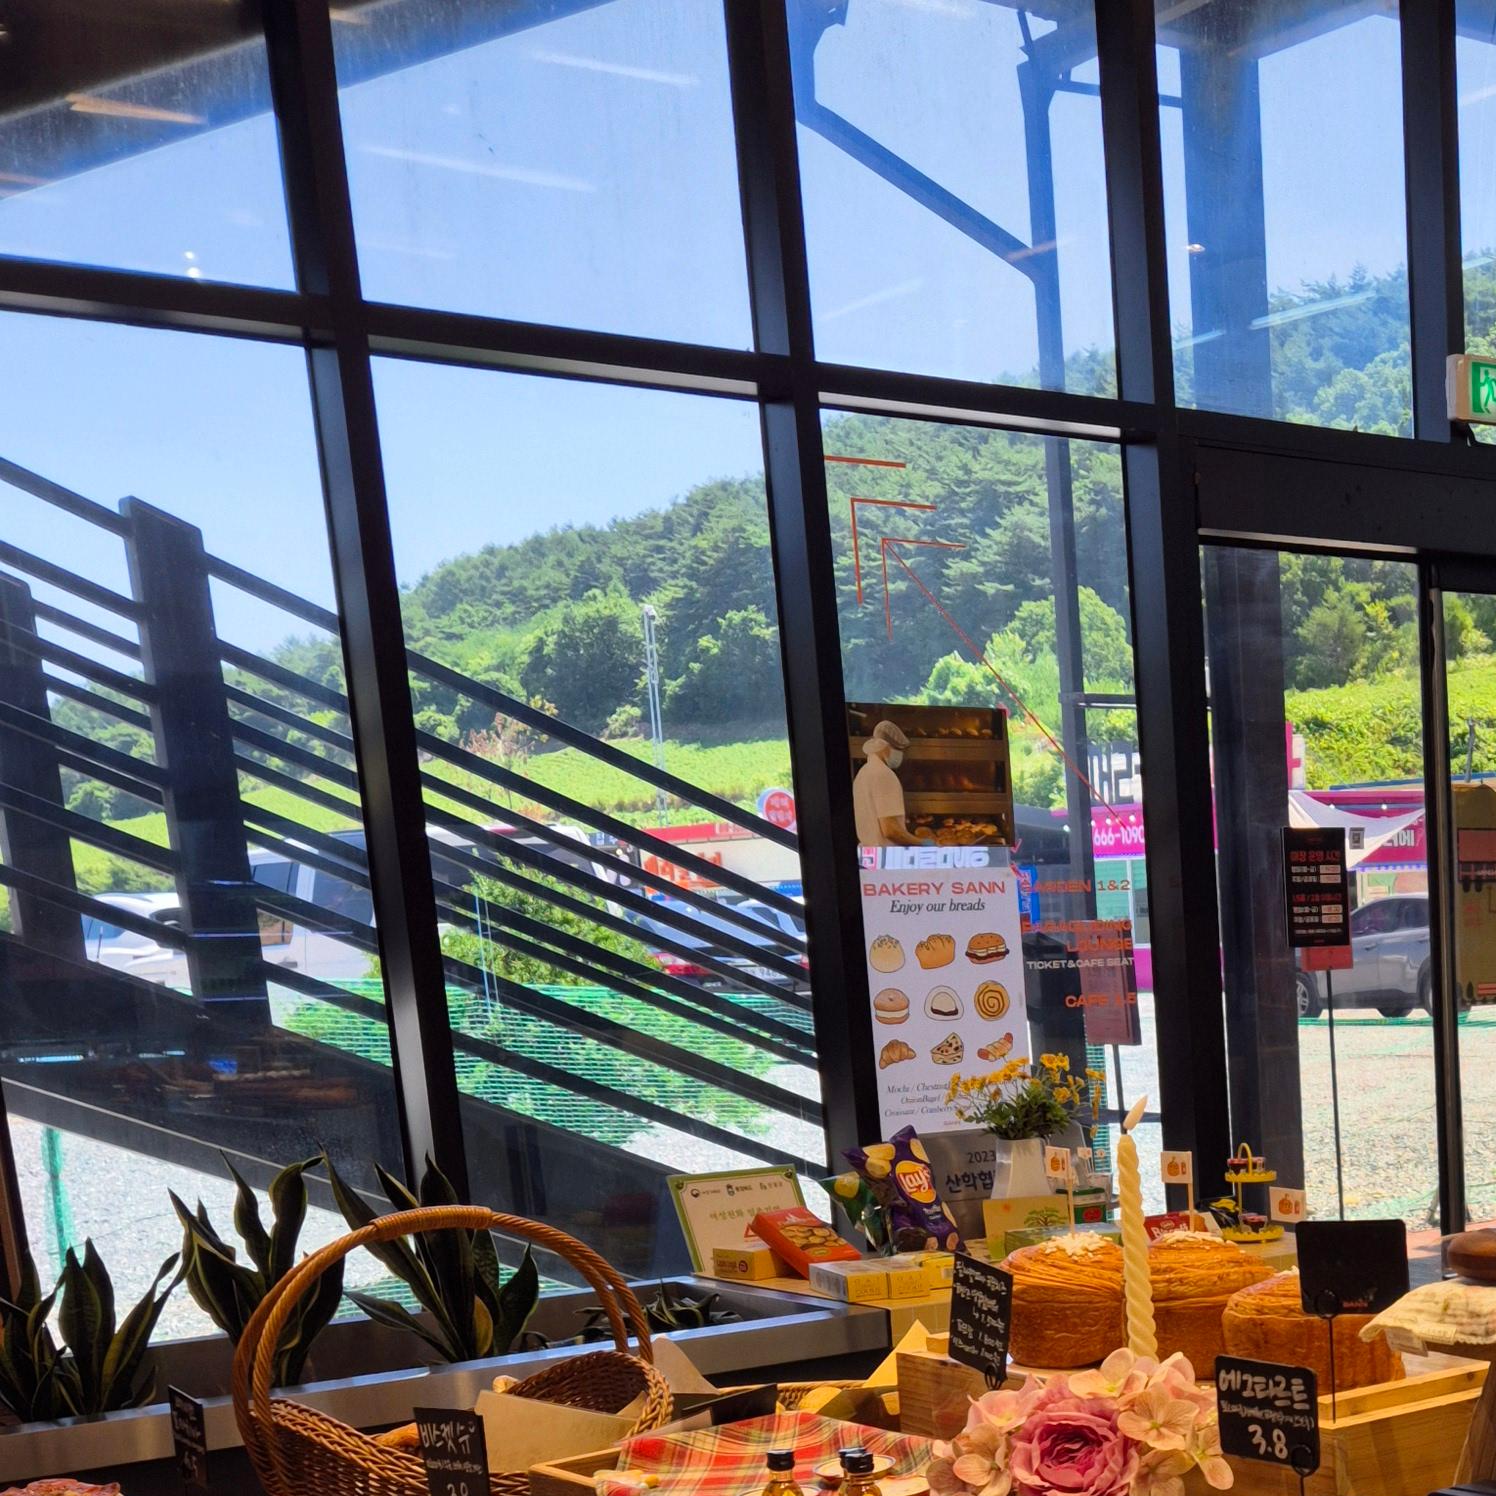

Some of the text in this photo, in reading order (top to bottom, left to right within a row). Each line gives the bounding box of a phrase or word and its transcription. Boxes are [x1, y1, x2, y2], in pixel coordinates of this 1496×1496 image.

[863, 881, 1006, 897] BAKERY SANN
[1097, 880, 1131, 892] 1&2
[889, 898, 986, 915] Enjoy our breads
[1026, 957, 1135, 970] TICKET&CAFE SEAT
[967, 1150, 998, 1164] 2023
[899, 1166, 932, 1195] Lay's
[945, 1170, 996, 1195] 산학협
[1218, 1368, 1311, 1411] 에그타르트
[1247, 1423, 1289, 1460] 3.8
